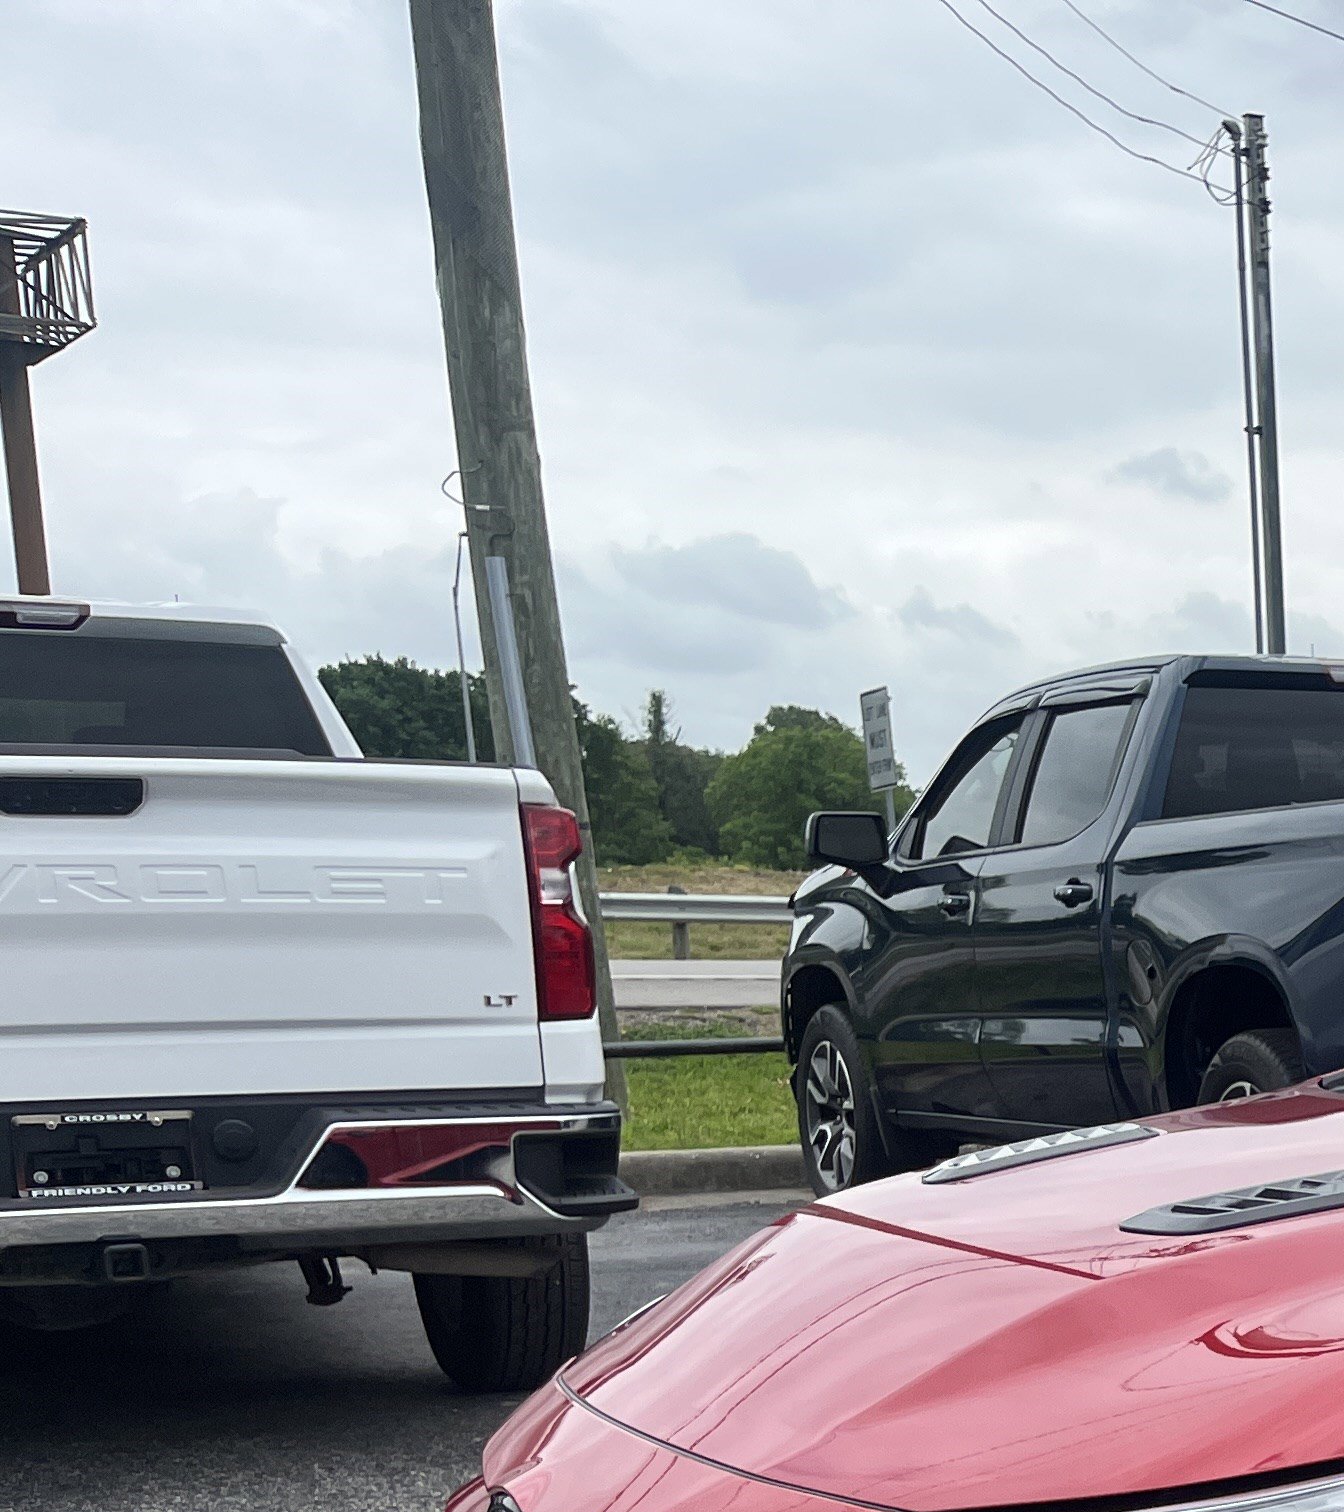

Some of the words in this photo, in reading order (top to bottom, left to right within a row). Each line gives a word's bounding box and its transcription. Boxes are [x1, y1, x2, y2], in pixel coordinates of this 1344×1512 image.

[483, 995, 518, 1007] LT
[64, 1113, 144, 1123] CROSBY
[31, 1185, 130, 1198] FRIENDLY
[135, 1183, 192, 1193] FORD
